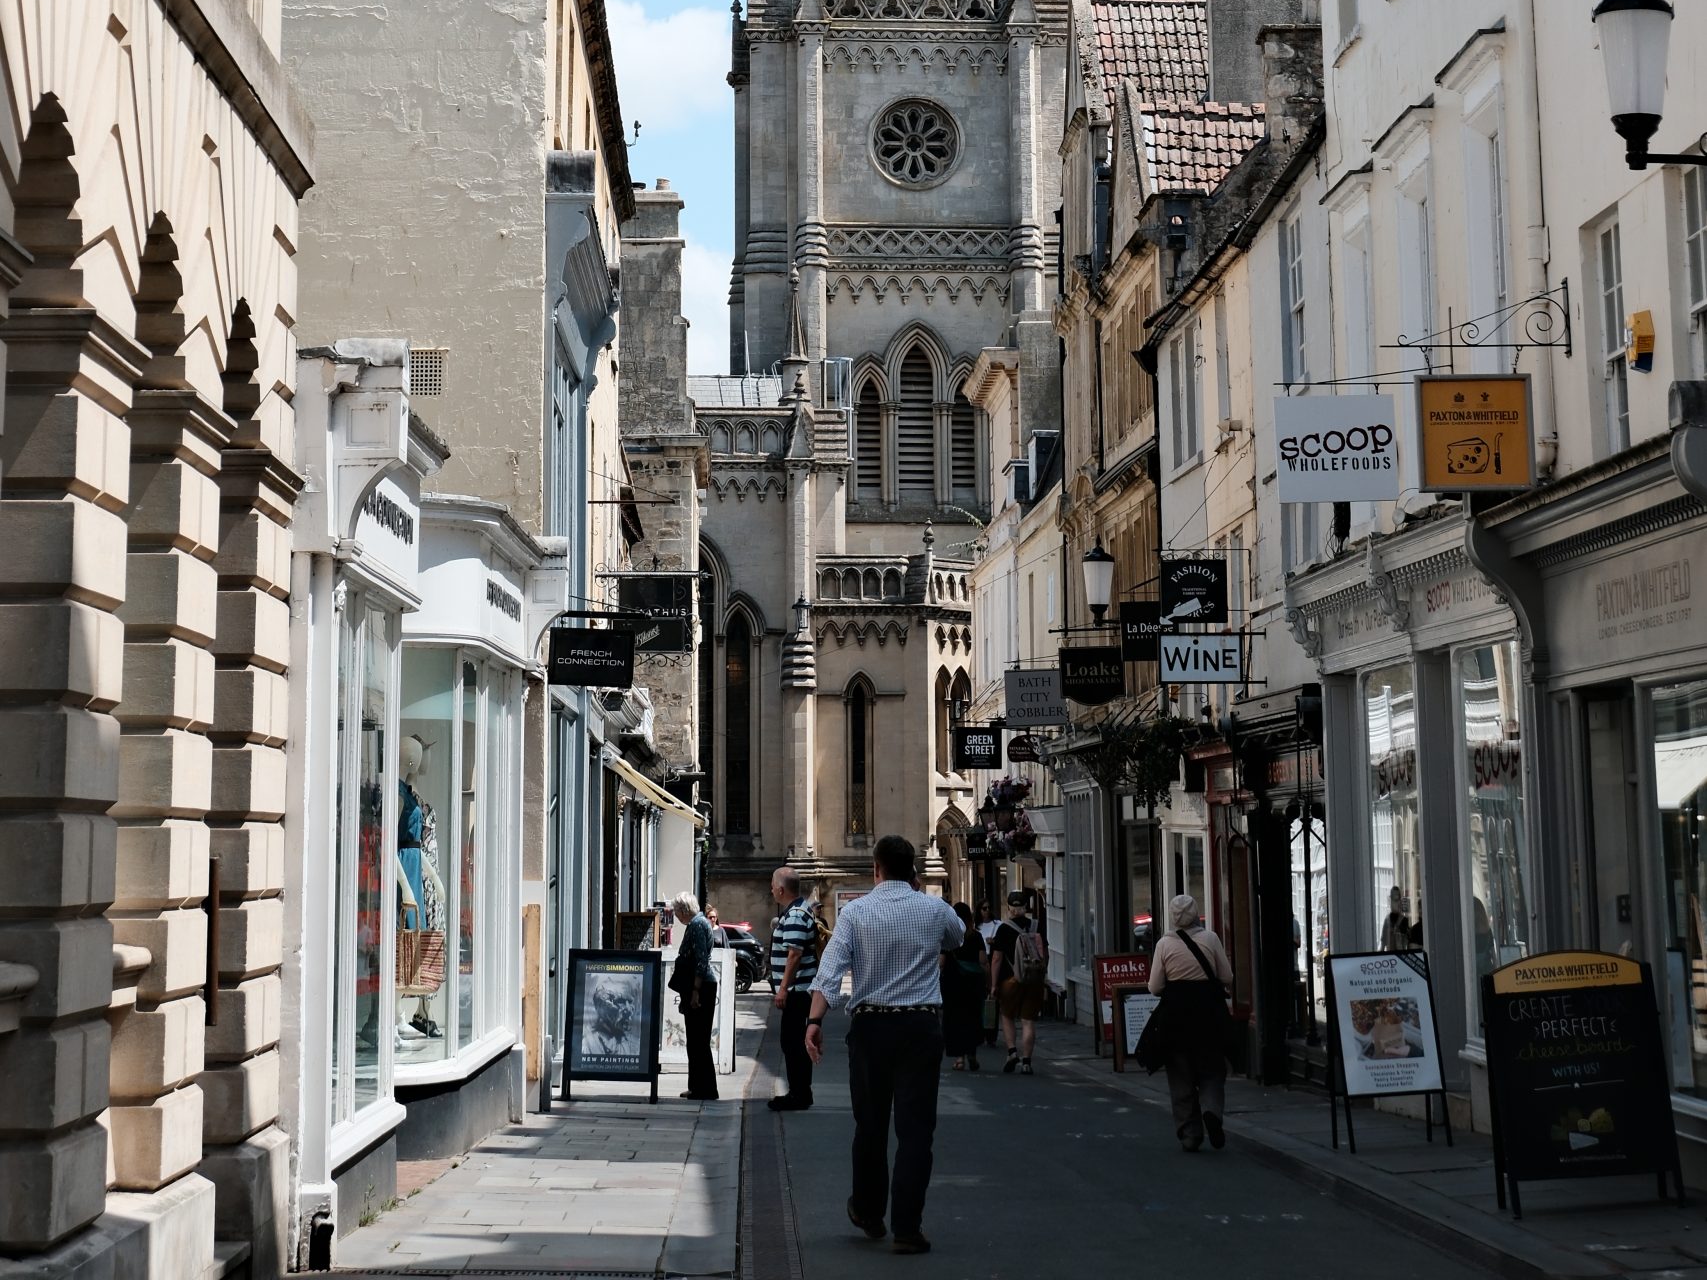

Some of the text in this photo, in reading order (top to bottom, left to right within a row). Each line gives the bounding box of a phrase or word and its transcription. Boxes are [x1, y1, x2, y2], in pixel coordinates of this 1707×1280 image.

[1287, 456, 1392, 472] WHOLEFOODS
[1170, 565, 1218, 583] FASHION
[1452, 577, 1491, 605] WHOLEFOO
[1127, 623, 1138, 633] La
[570, 650, 613, 658] FRENCH
[558, 658, 625, 666] CONNECTION
[1065, 660, 1120, 676] Loake
[1018, 677, 1051, 688] BATH
[1020, 692, 1050, 702] CITY
[966, 734, 993, 744] GREEN
[964, 745, 996, 755] STREET
[1102, 960, 1145, 974] Loake
[1350, 978, 1373, 986] Natural
[1388, 976, 1413, 985] Organic
[1363, 986, 1401, 994] Wholefoods
[1508, 994, 1576, 1022] CREATE
[1540, 1016, 1608, 1040] PERFECT
[1551, 1062, 1582, 1078] WITH
